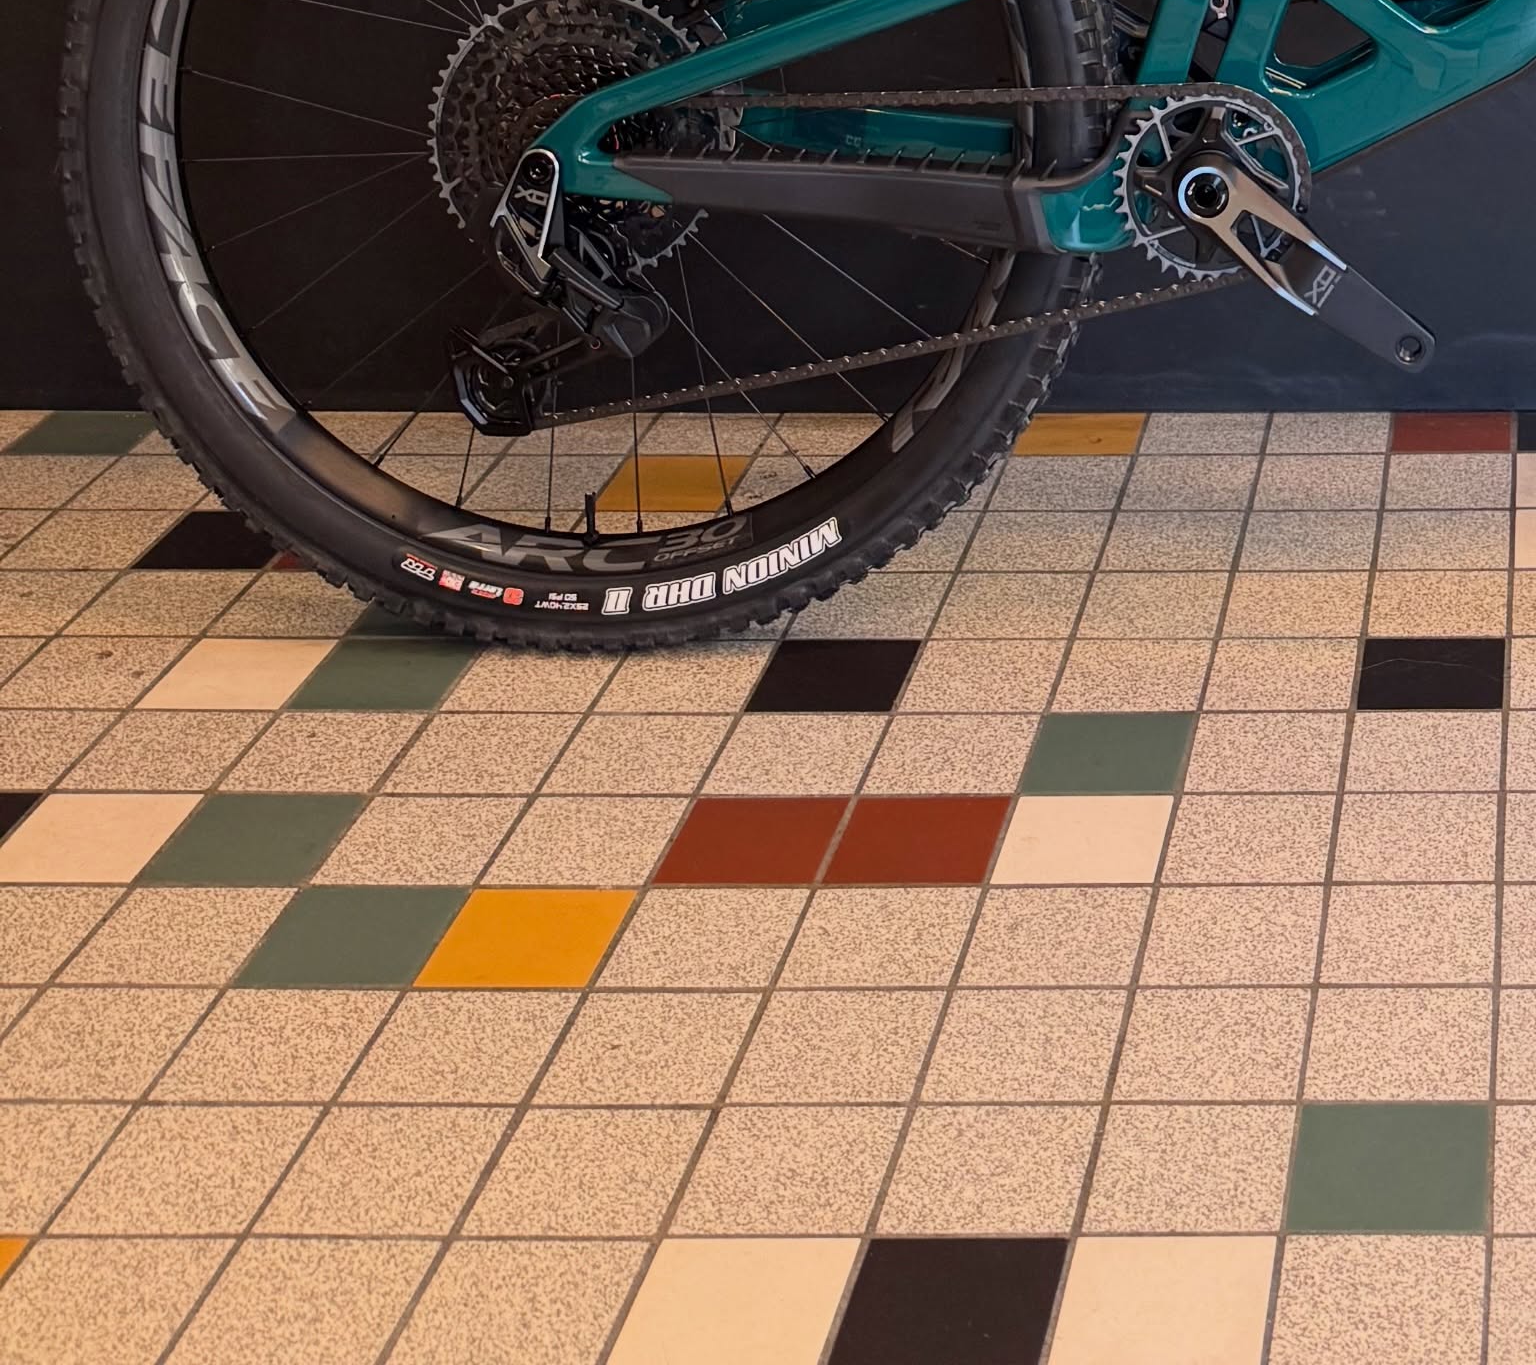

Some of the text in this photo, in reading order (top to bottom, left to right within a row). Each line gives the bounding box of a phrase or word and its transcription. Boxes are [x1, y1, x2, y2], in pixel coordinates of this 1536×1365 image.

[421, 515, 747, 572] ARC 30
[653, 536, 735, 562] OFFSET
[722, 516, 844, 596] MINION
[548, 592, 578, 601] 50 PSI
[642, 571, 717, 612] DHR
